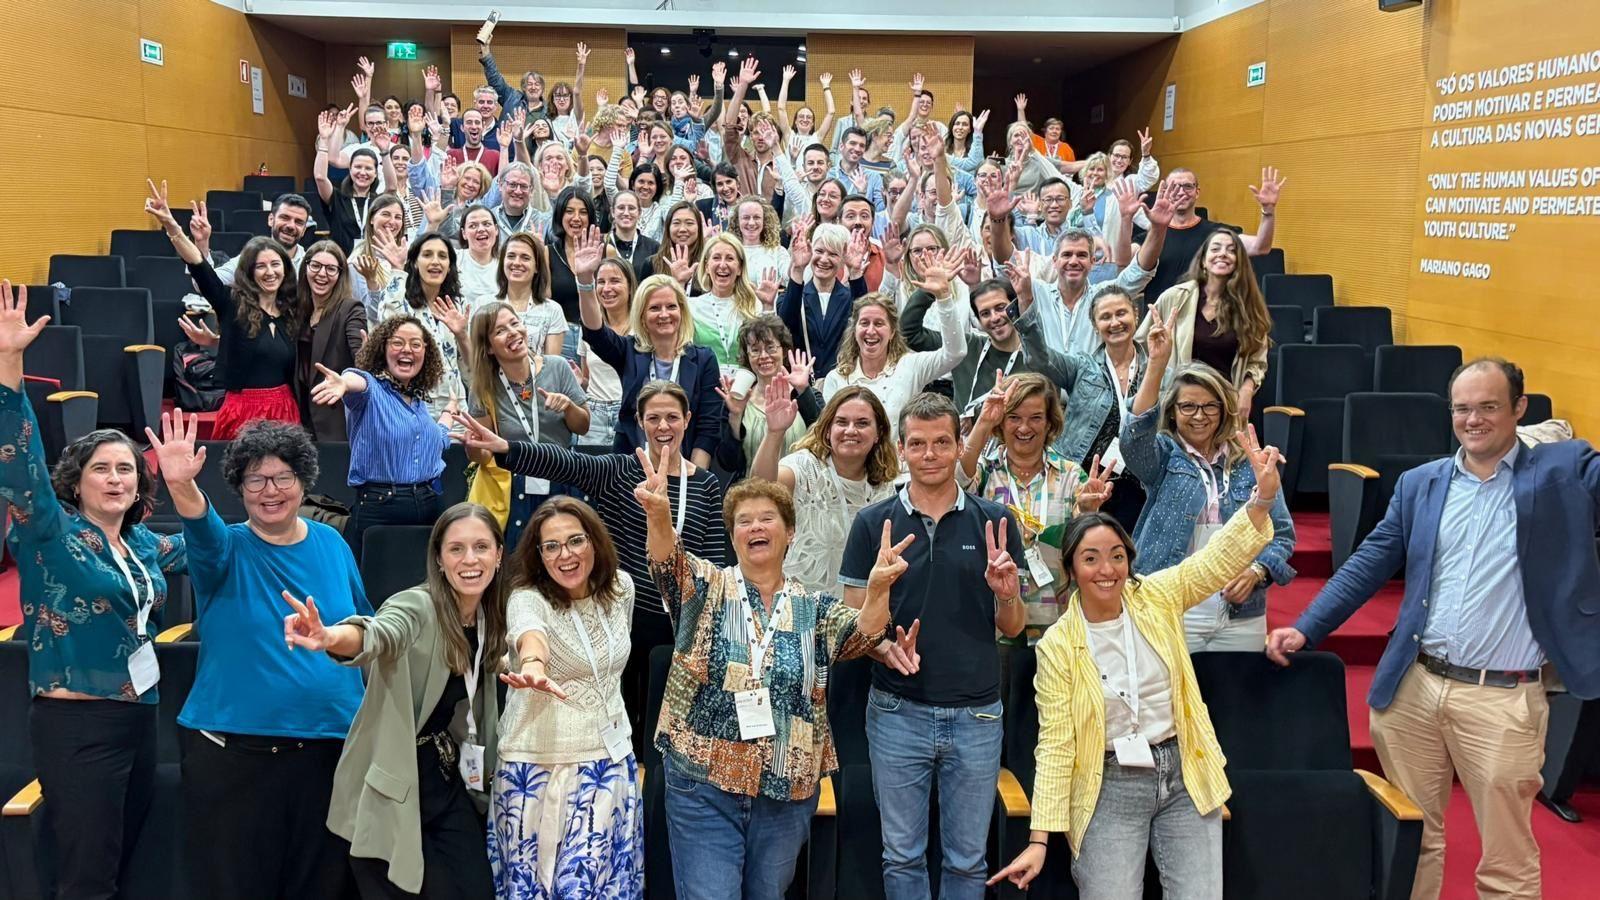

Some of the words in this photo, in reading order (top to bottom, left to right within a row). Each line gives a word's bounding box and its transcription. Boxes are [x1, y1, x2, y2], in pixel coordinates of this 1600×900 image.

[1458, 73, 1475, 93] OS
[1477, 62, 1534, 89] VALORES
[1537, 51, 1600, 80] HUMANO
[1433, 100, 1472, 122] PODEM
[1474, 93, 1531, 118] MOTIVAR
[1533, 91, 1544, 111] E
[1431, 131, 1439, 148] A
[1441, 126, 1493, 148] CULTURA
[1495, 122, 1522, 143] DAS
[1524, 117, 1573, 140] NOVAS
[1460, 172, 1481, 189] THE
[1483, 171, 1526, 188] HUMAN
[1528, 168, 1579, 188] VALUES
[1581, 167, 1600, 187] OF
[1425, 197, 1446, 213] CAN
[1449, 197, 1501, 214] MOTIVATE
[1503, 197, 1530, 214] AND
[1424, 221, 1456, 238] YOUTH
[1420, 258, 1461, 277] MARIANO
[1462, 263, 1491, 280] GAGO
